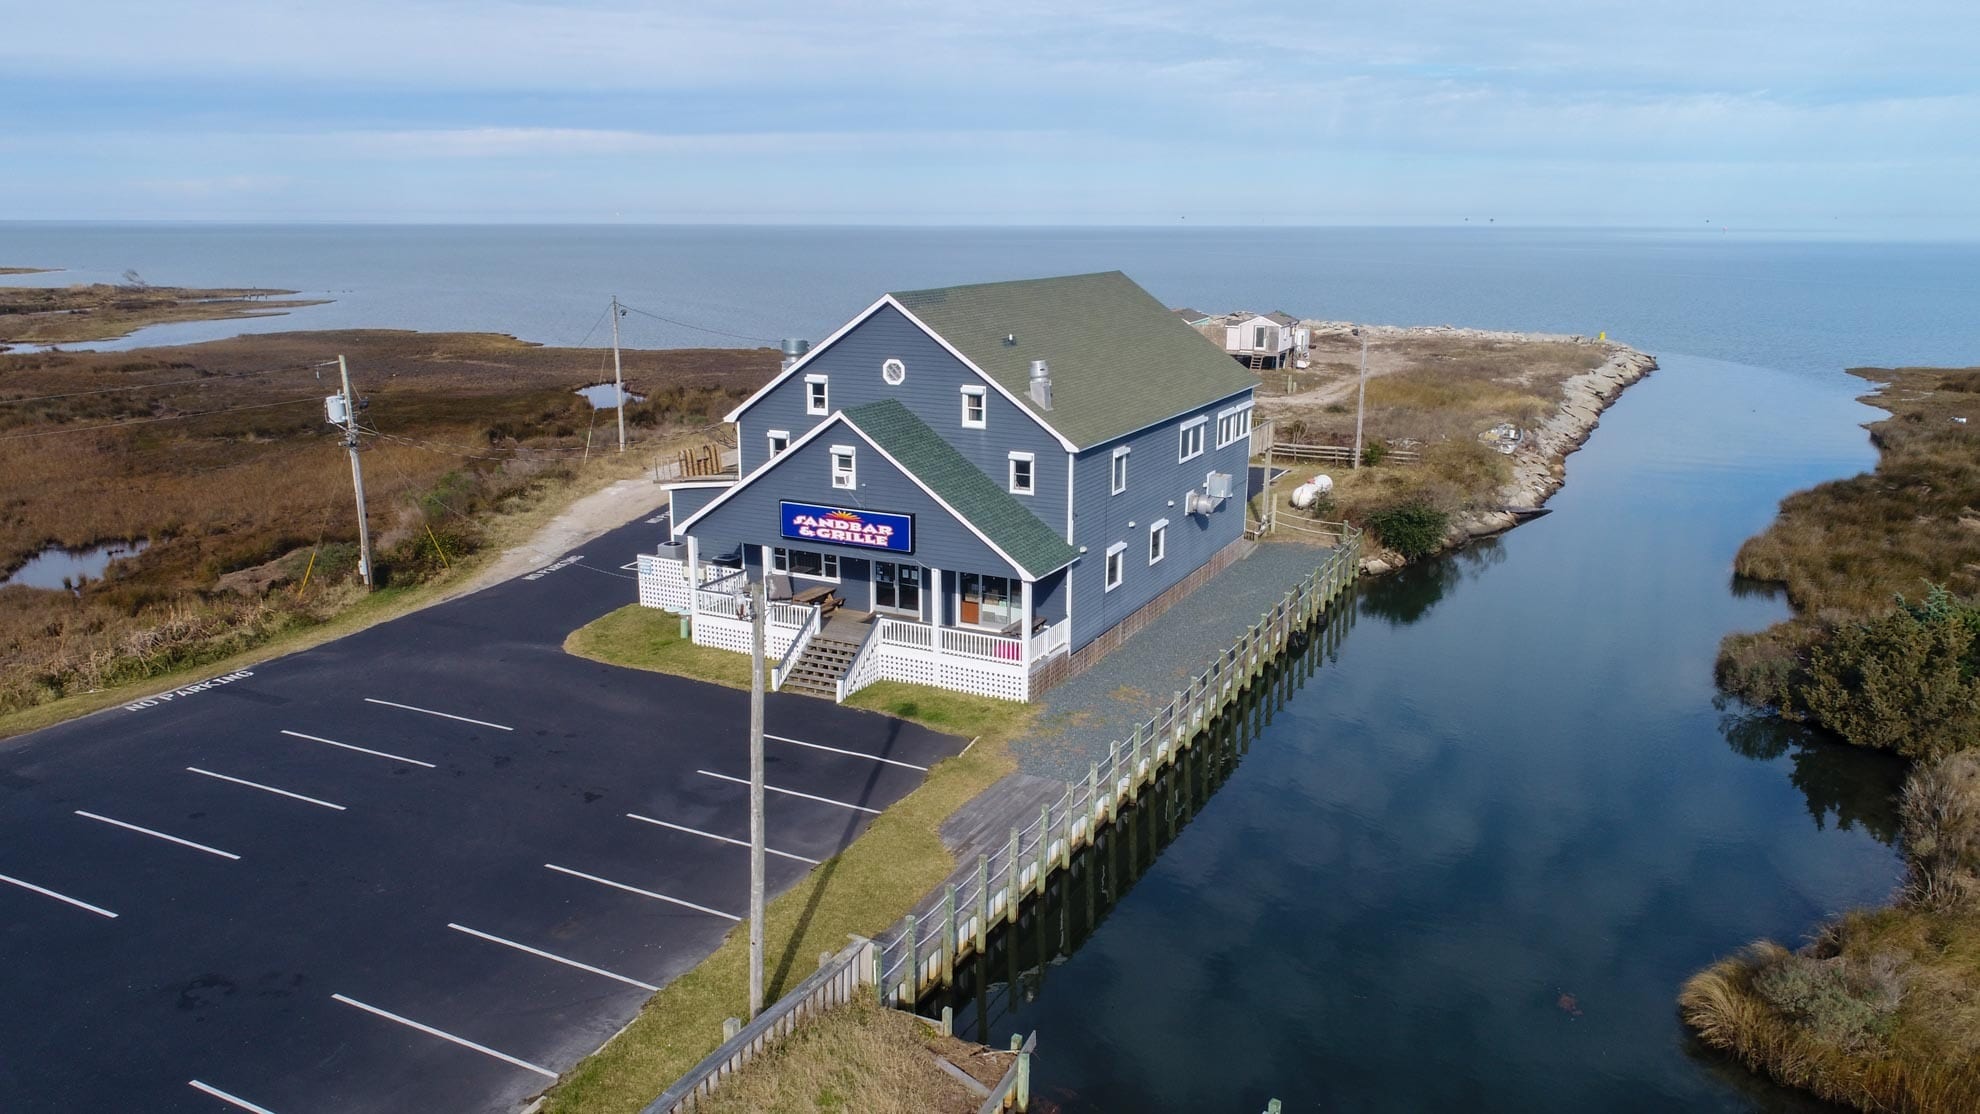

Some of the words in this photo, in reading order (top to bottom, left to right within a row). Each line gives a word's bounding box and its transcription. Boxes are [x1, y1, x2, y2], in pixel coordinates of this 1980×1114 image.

[792, 515, 894, 537] SANDBAR
[799, 526, 816, 537] &
[815, 527, 889, 547] GRILLE
[124, 700, 160, 712] NO
[158, 670, 255, 701] PARKING
